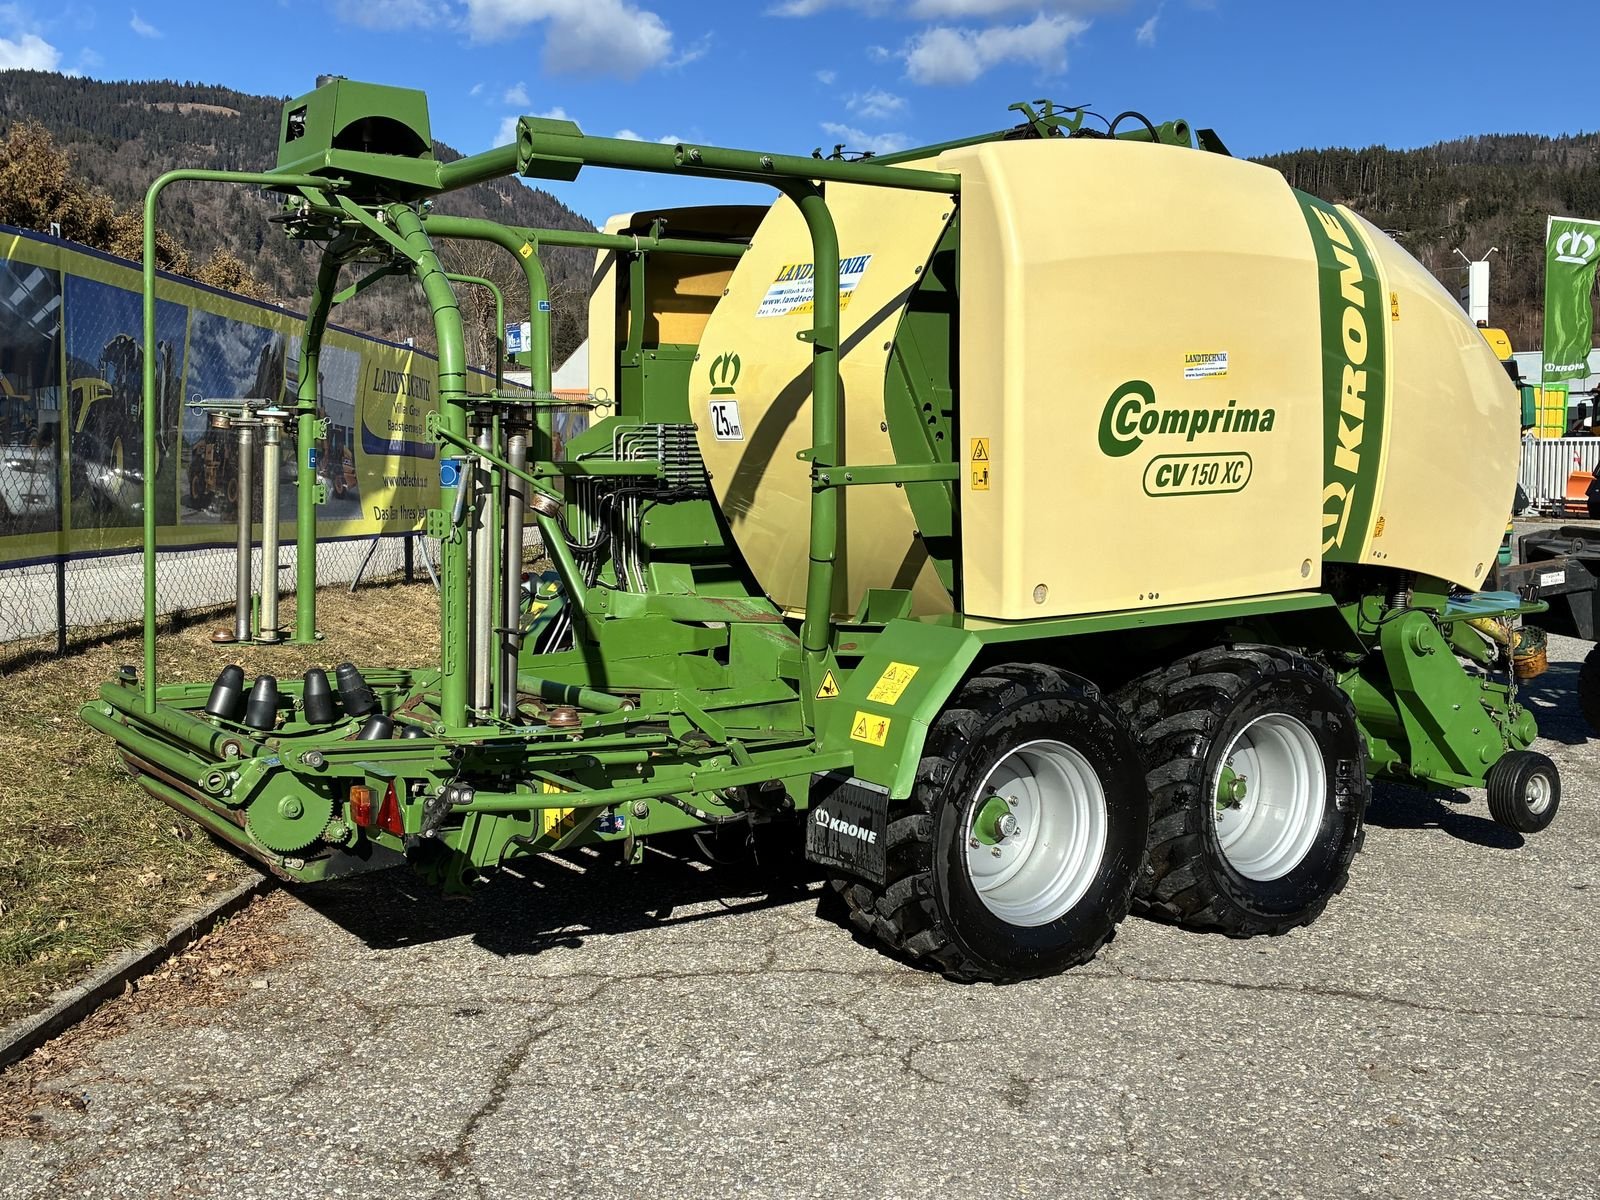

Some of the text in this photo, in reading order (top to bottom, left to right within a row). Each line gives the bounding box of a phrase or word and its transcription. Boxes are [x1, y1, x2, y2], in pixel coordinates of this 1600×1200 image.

[1310, 205, 1368, 474] KRONE
[1185, 353, 1227, 363] LANDTECHNIK
[1155, 461, 1244, 488] CV 150 XC
[373, 506, 389, 521] Das
[829, 817, 878, 844] KRONE
